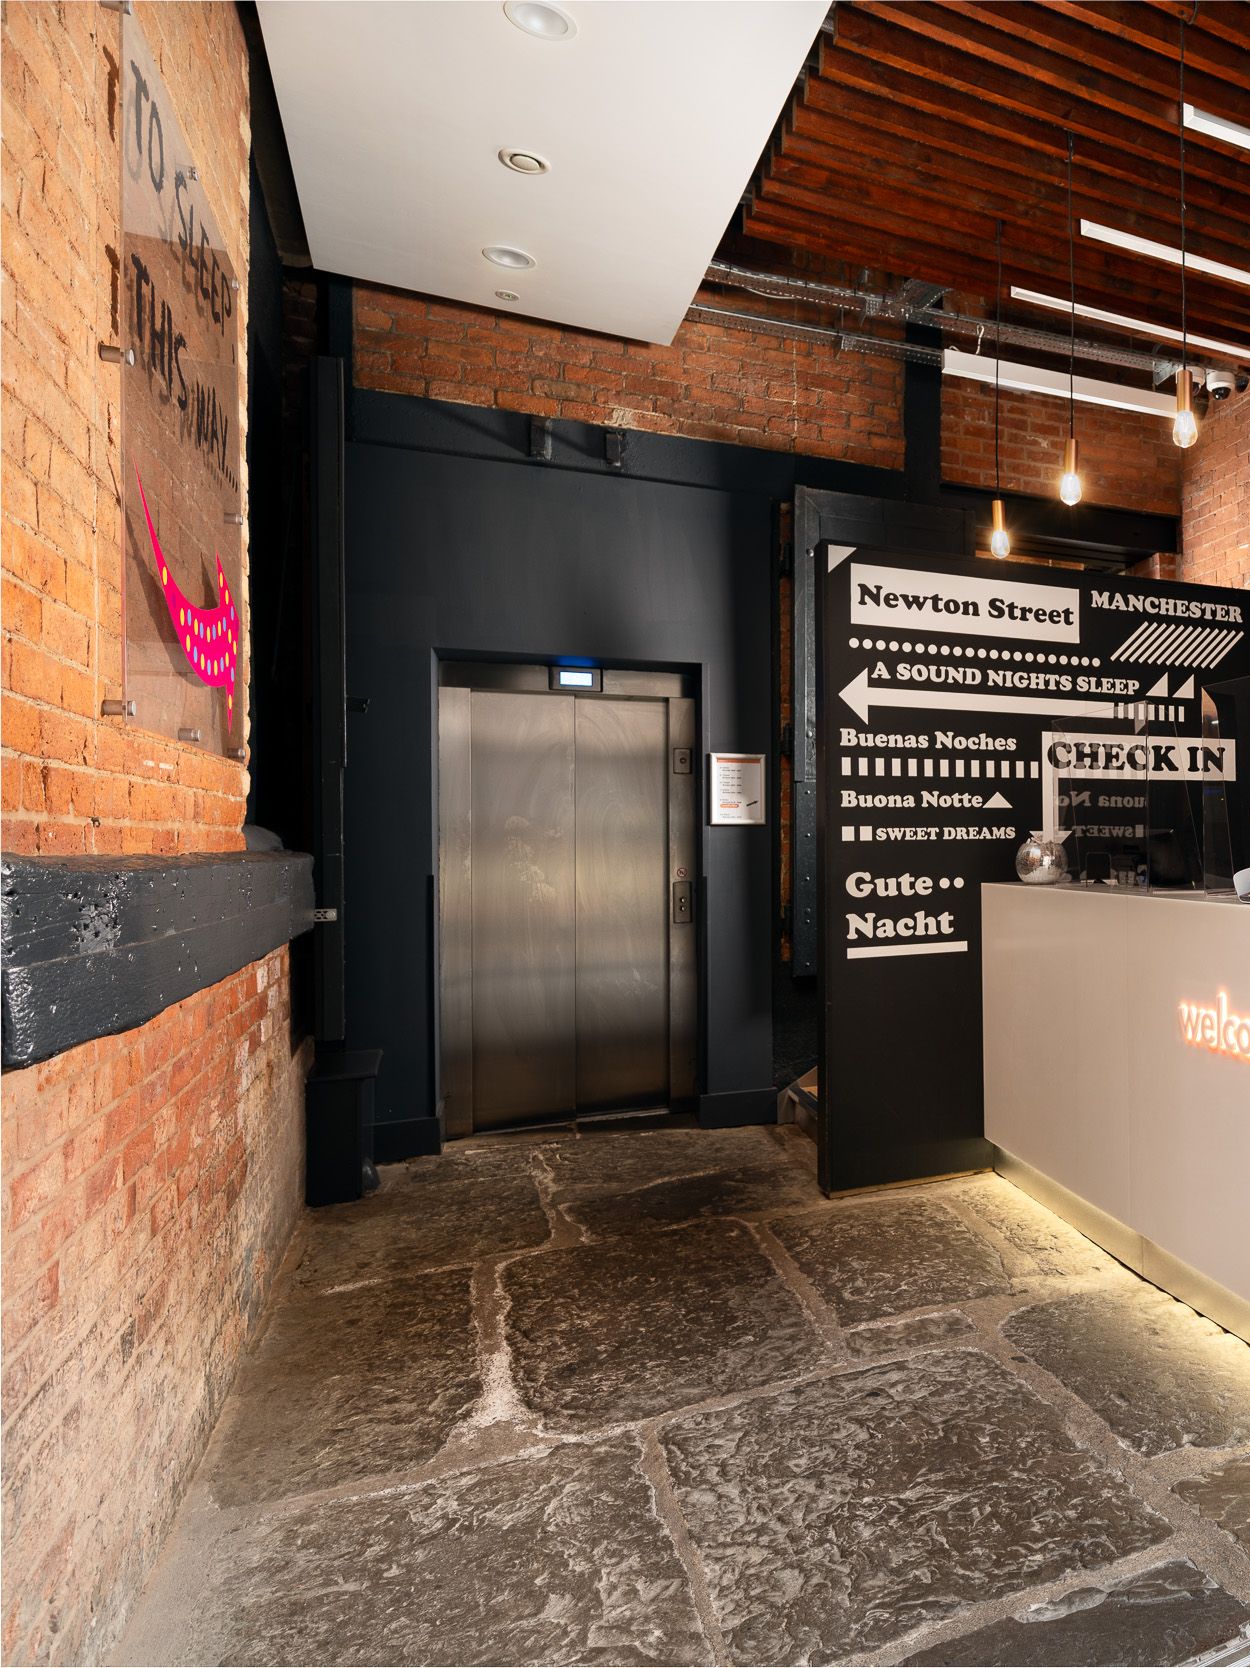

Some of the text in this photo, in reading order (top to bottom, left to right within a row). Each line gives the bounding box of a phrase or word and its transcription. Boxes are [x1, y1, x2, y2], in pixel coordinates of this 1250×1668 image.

[130, 60, 164, 194] TO
[131, 253, 188, 411] THIS
[857, 583, 1075, 626] Newton Street
[1090, 590, 1243, 623] MANCHESTER
[871, 661, 1140, 695] A SOUND NIGHTS SLEEP
[840, 728, 1017, 751] Buenas Noches
[1047, 741, 1226, 773] CHECK IN
[840, 790, 983, 808] Buona Notte
[876, 826, 1016, 840] SWEET DREAMS
[845, 871, 934, 898] Gute
[845, 910, 954, 940] Nacht
